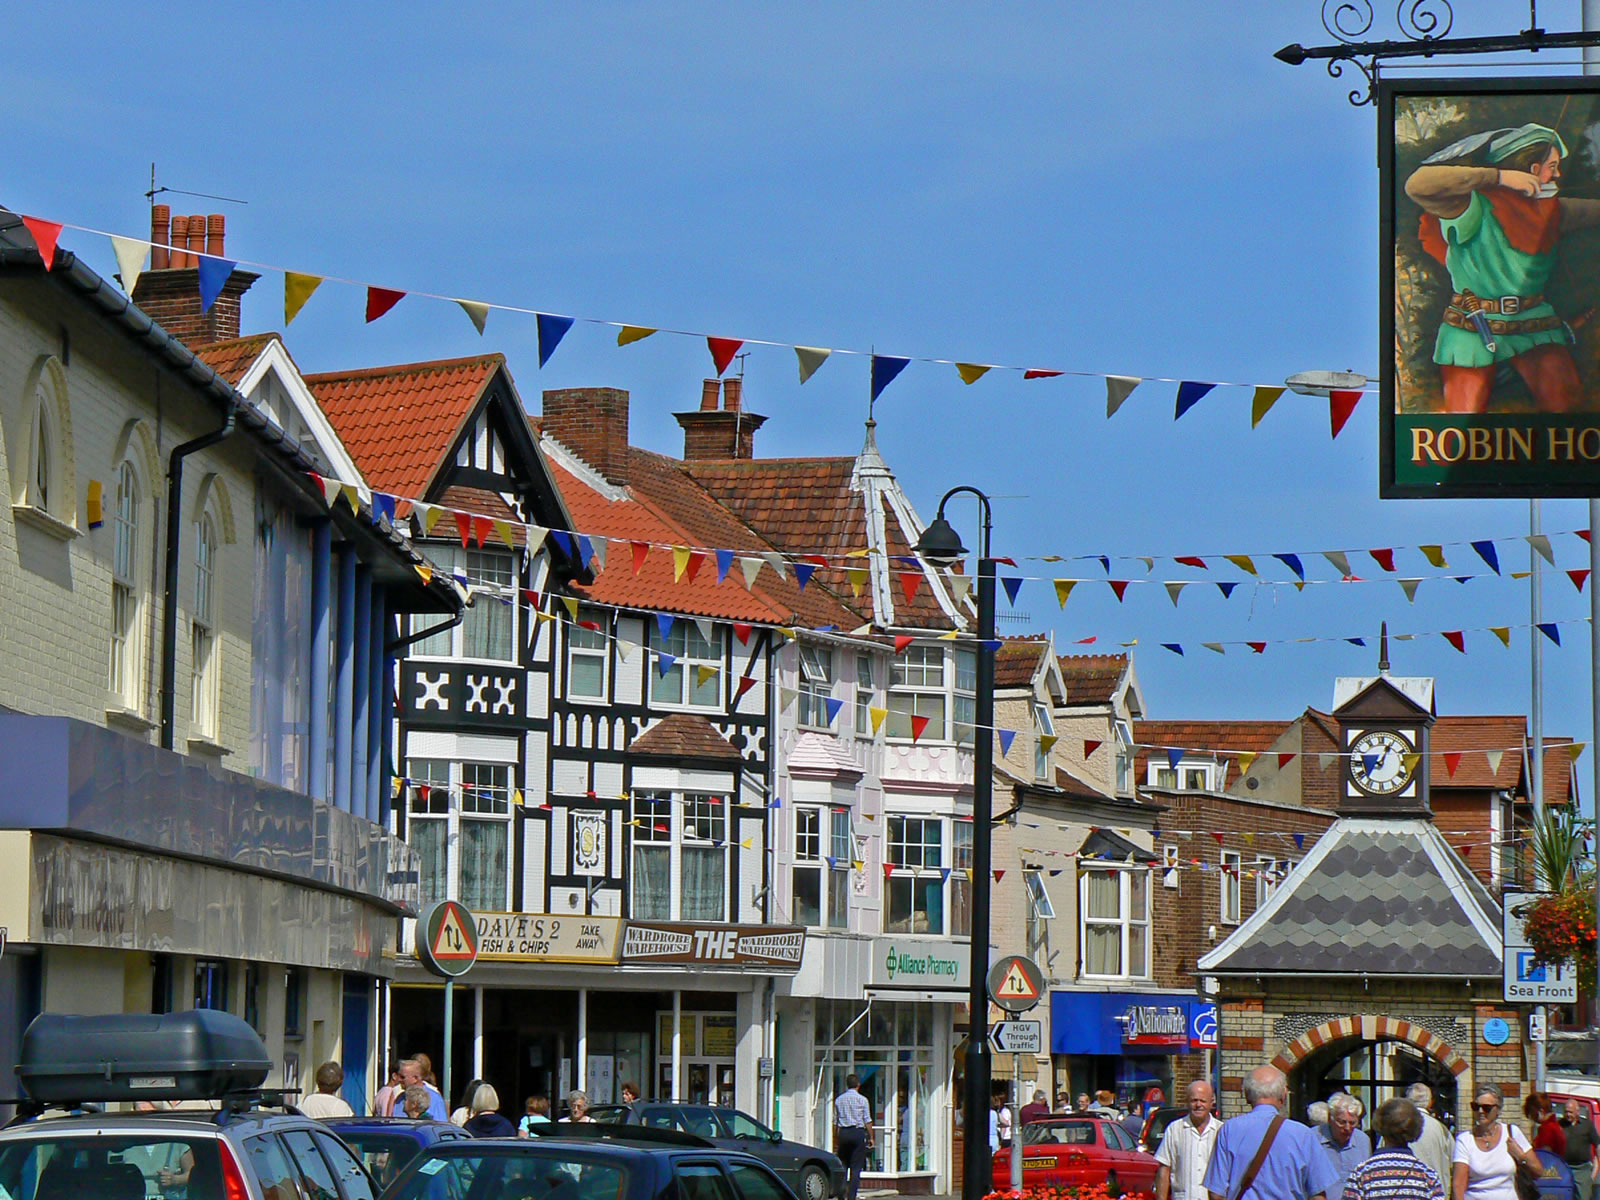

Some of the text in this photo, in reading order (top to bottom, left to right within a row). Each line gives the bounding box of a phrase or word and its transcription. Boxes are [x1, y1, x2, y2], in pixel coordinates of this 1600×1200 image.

[1409, 427, 1533, 463] ROBIN
[477, 916, 561, 939] DAVE'S 2
[580, 925, 601, 936] TAKE
[627, 927, 691, 944] WARDROBE
[741, 933, 801, 946] WARDROBE
[481, 939, 550, 954] FISH & CHIPS
[576, 938, 600, 950] AWAY
[626, 941, 689, 955] WAREHOUSE
[694, 930, 738, 959] THE
[740, 945, 800, 960] WAREHOUSE
[897, 953, 960, 982] Alliance Pharmacy
[1508, 984, 1574, 997] Sea Front
[1137, 1005, 1186, 1034] Nationwide
[1012, 1024, 1031, 1032] HGV
[1006, 1032, 1039, 1042] Through
[1010, 1041, 1035, 1049] traffic
